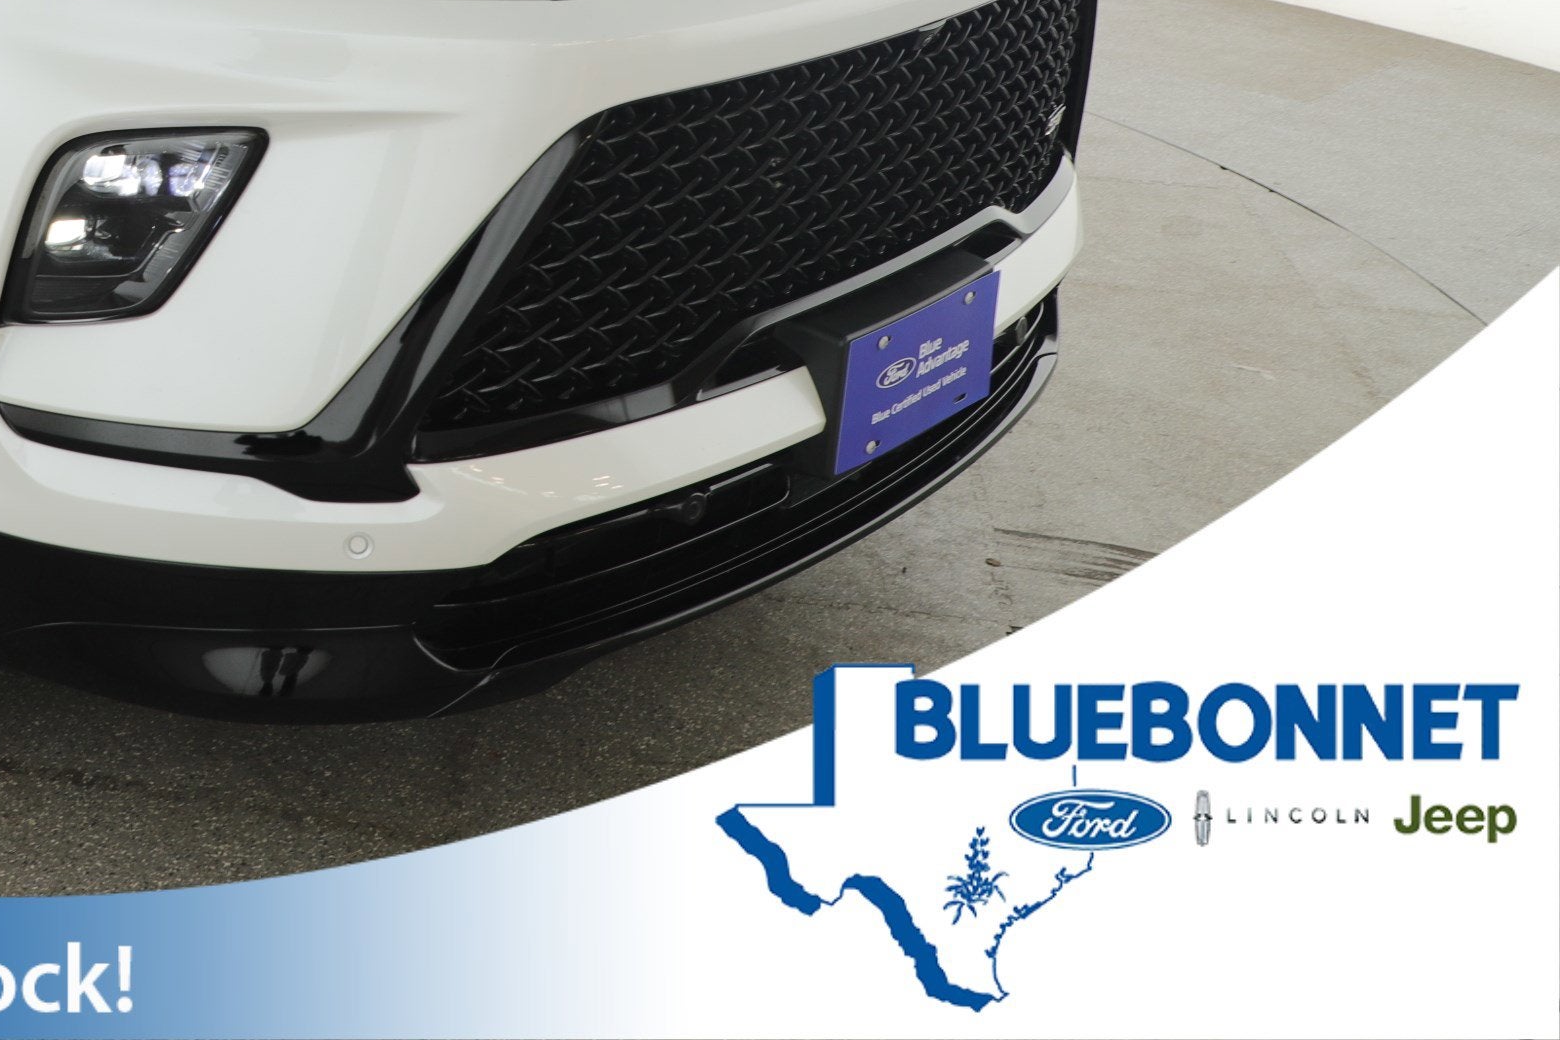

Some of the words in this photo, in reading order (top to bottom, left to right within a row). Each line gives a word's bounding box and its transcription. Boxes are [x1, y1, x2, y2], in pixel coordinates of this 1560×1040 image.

[915, 339, 970, 378] Advantage
[918, 337, 943, 359] Blue
[871, 409, 891, 425] Blue
[891, 389, 923, 415] Certified
[922, 378, 942, 397] Used
